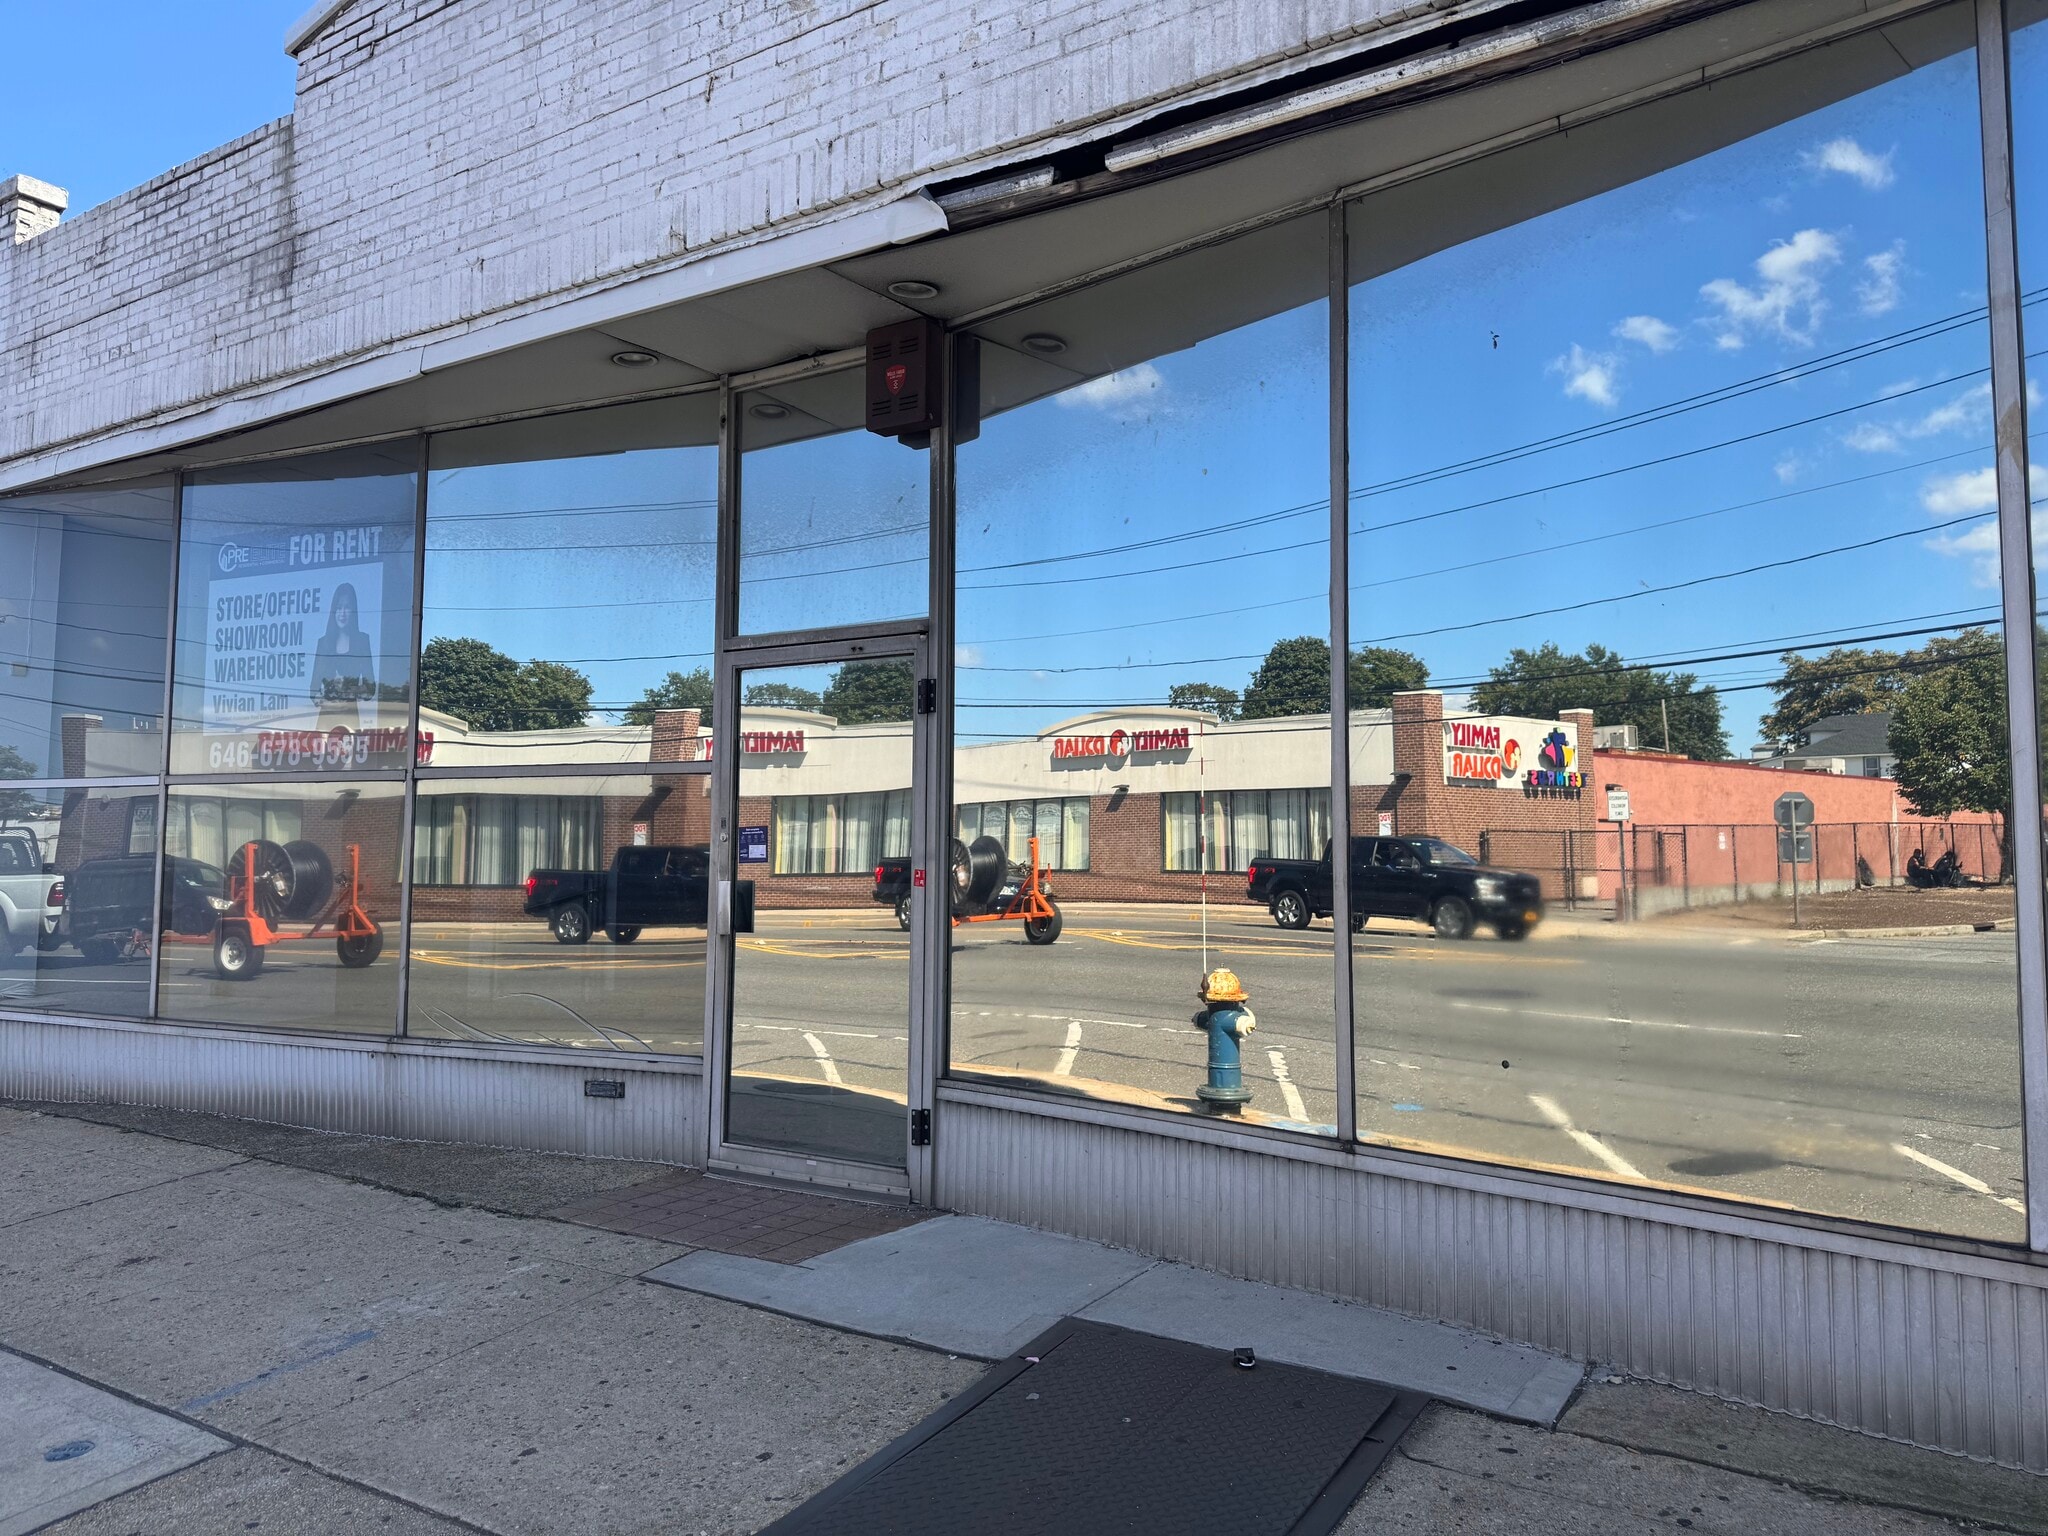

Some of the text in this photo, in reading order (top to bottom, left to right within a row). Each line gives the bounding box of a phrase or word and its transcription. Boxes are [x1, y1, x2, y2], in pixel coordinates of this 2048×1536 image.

[289, 526, 383, 566] FOR RENT
[216, 587, 321, 622] STORE/OFFICE
[215, 621, 303, 652] SHOWROOM
[214, 652, 306, 682] WAREHOUSE
[212, 692, 289, 714] Vivian Lam
